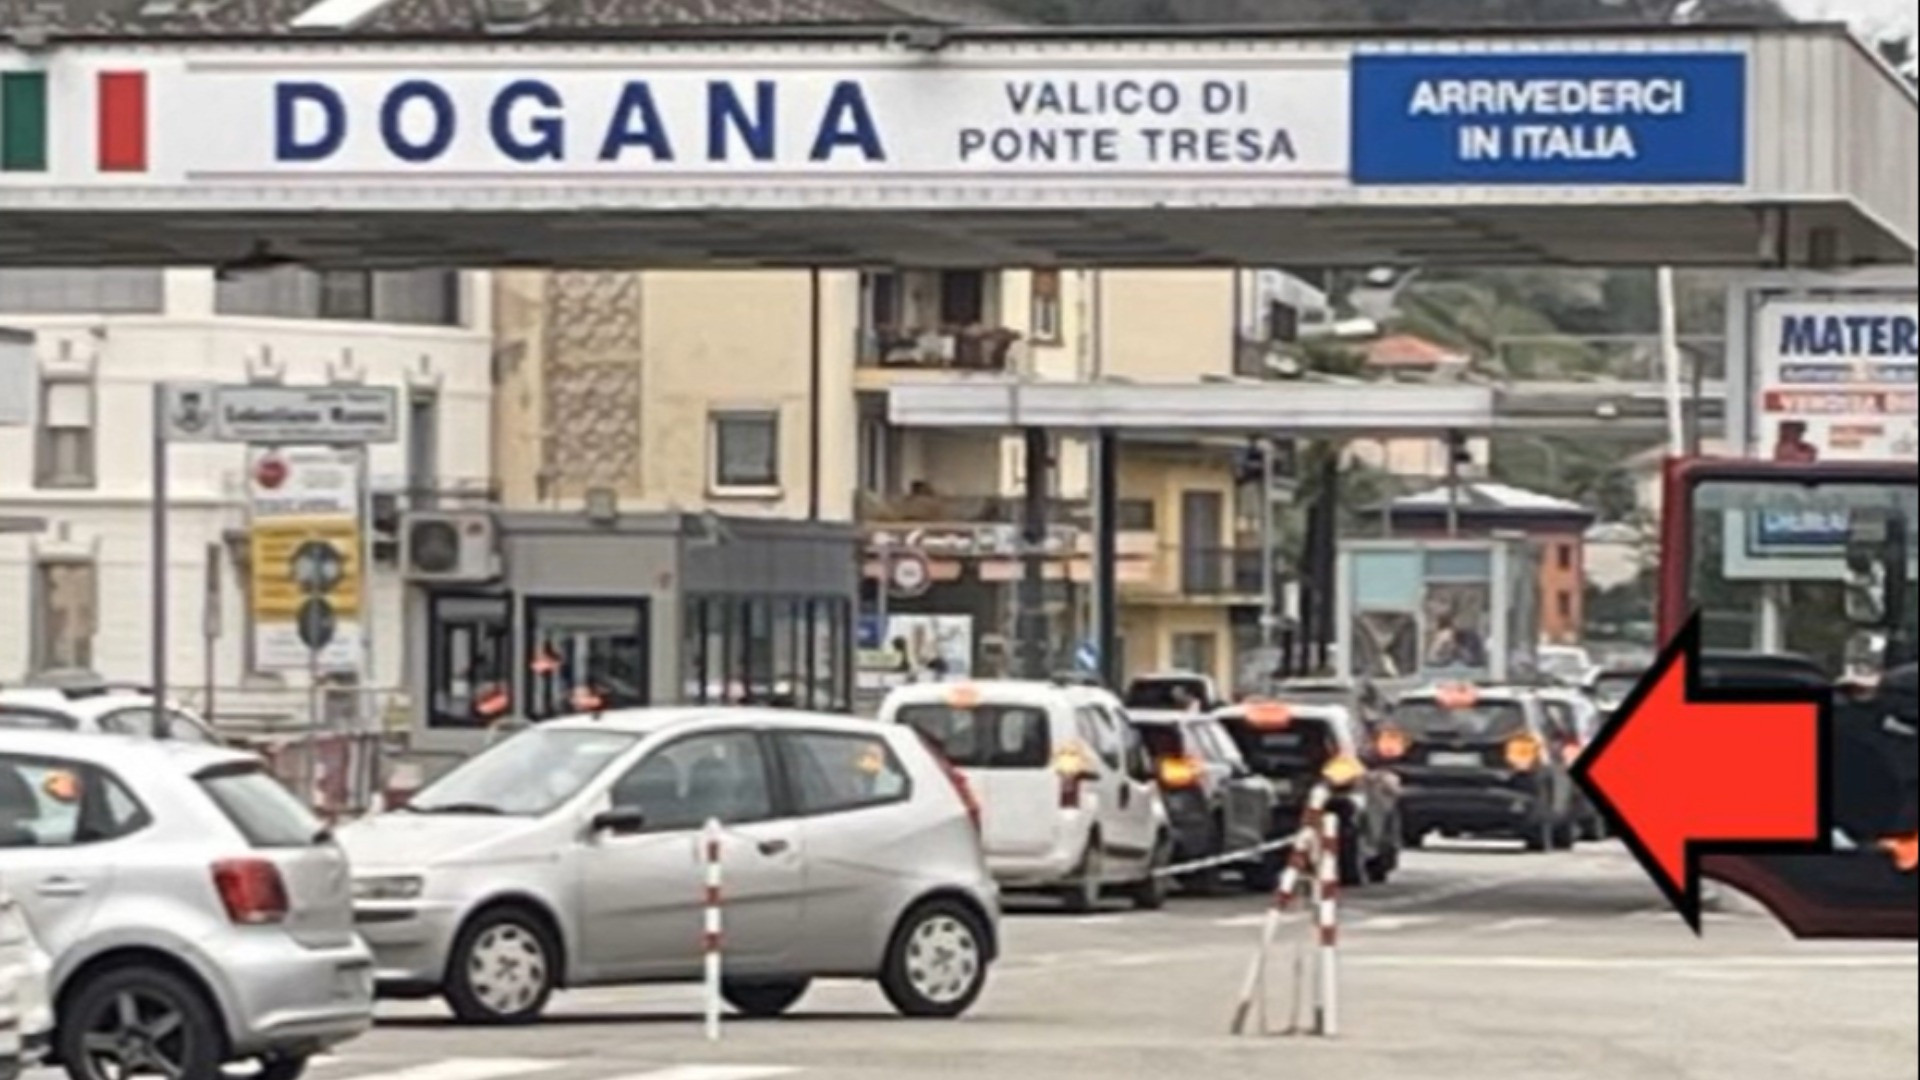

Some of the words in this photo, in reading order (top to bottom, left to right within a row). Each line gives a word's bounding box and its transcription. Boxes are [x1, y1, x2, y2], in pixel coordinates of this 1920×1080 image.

[1005, 81, 1179, 115] VALICO
[1202, 81, 1247, 114] DI
[1408, 79, 1685, 116] ARRIVEDERCI
[274, 80, 886, 162] DOGANA
[958, 128, 1117, 163] PONTE
[1140, 128, 1297, 163] TRESA
[1459, 125, 1501, 161] IN
[1512, 124, 1637, 161] ITALIA
